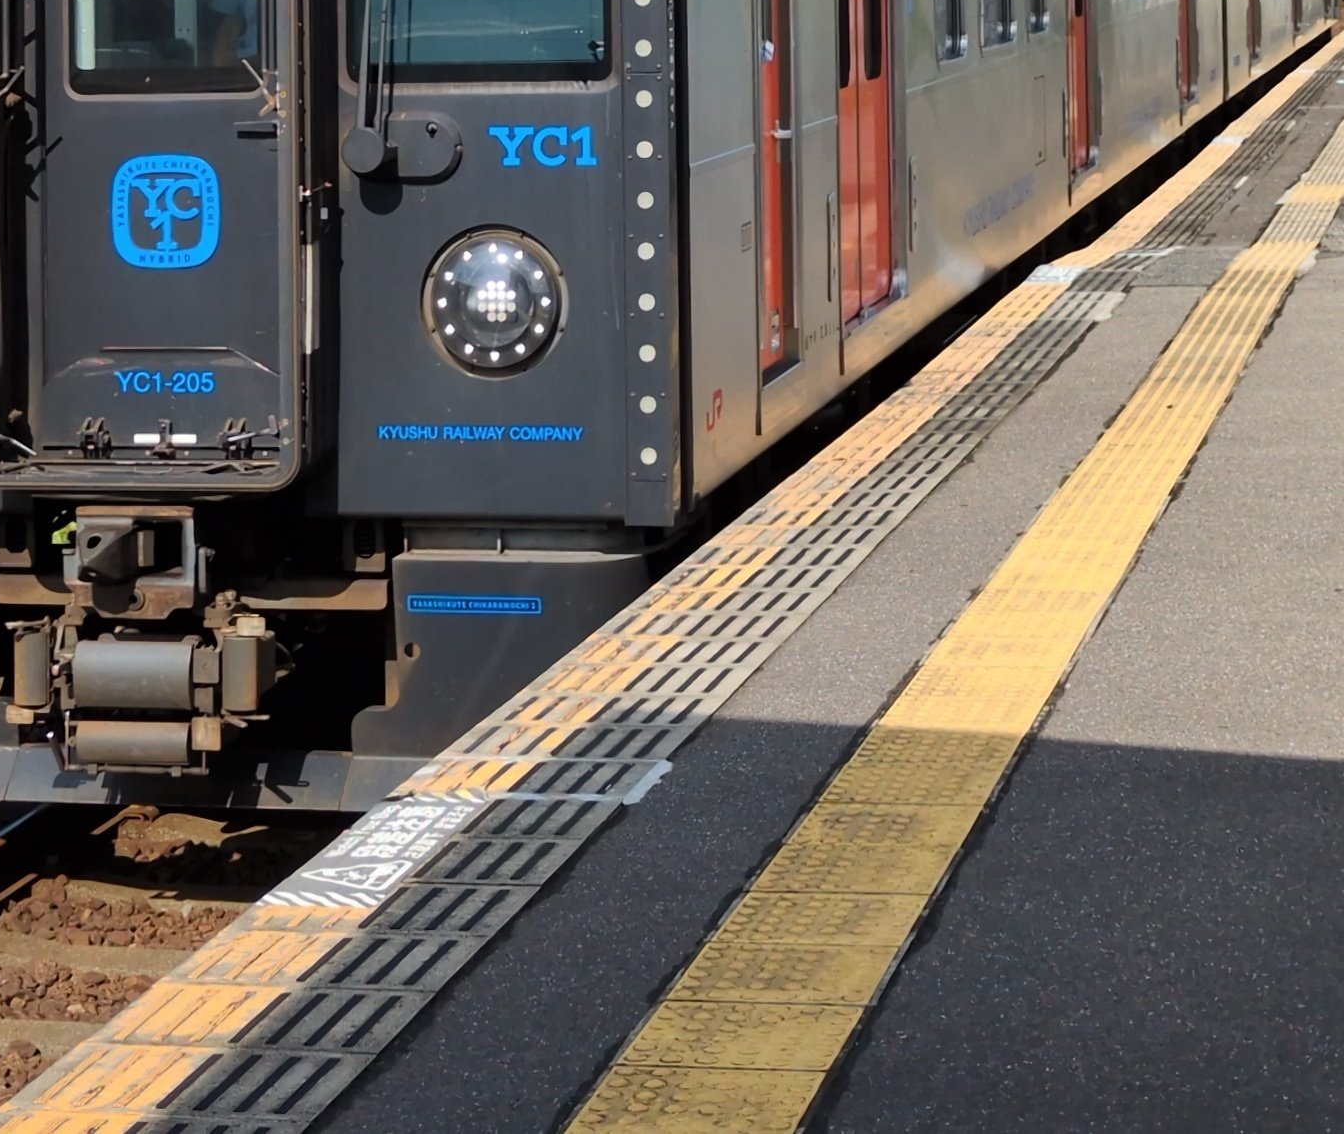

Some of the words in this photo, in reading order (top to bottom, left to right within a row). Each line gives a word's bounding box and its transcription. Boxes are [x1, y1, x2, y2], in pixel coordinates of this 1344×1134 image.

[488, 126, 598, 166] YC1
[117, 162, 157, 227] YASASHIKUTE
[139, 253, 191, 263] HYBRID
[115, 370, 215, 393] YC1-205
[706, 388, 723, 432] JR
[378, 425, 438, 440] KYUSHU
[443, 425, 505, 440] RAILWAY
[509, 426, 583, 441] COMPANY
